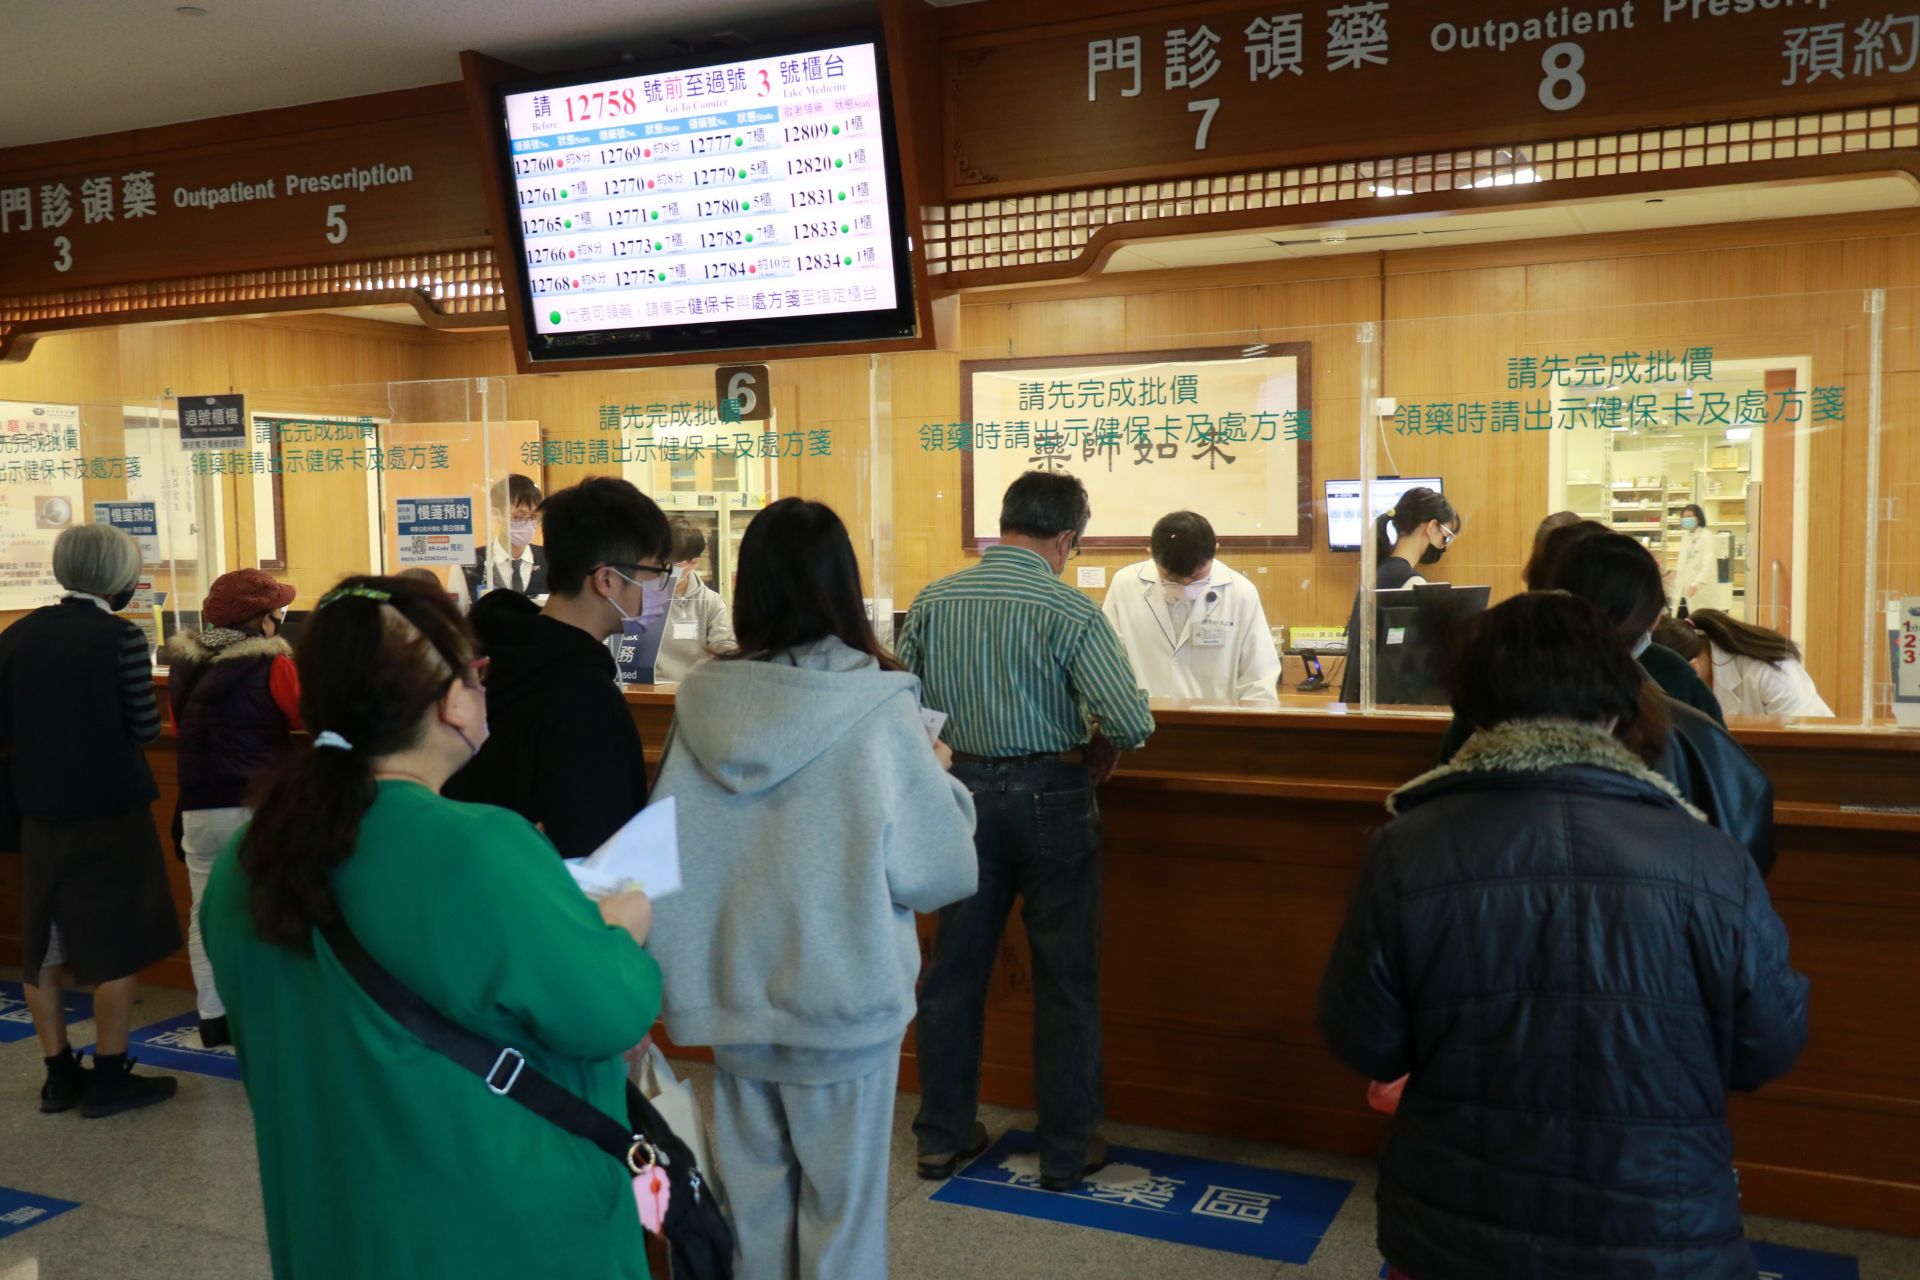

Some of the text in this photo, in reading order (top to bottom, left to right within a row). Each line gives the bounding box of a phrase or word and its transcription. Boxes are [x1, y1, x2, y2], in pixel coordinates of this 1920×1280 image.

[1431, 1, 1635, 52] Outpatient
[1088, 1, 1390, 102] 門診領藥
[1781, 14, 1920, 86] 預約
[533, 54, 845, 123] 請 12758 號前至過號 3 號櫃台
[1538, 42, 1586, 111] 8
[532, 83, 848, 132] Before Go To Counter Take Medicine
[1187, 98, 1221, 150] 7
[515, 156, 554, 175] 12760
[600, 145, 641, 165] 12769
[690, 134, 731, 154] 12777
[784, 123, 828, 143] 12809
[0, 171, 157, 233] 門診領藥
[173, 163, 414, 210] Outpatient Prescription
[519, 187, 557, 205] 12761
[604, 177, 645, 196] 12770
[693, 166, 736, 186] 12779
[787, 156, 832, 176] 12820
[326, 204, 348, 244] 5
[523, 217, 562, 235] 12765
[608, 208, 647, 226] 12771
[697, 198, 739, 217] 12780
[790, 189, 833, 208] 12831
[54, 236, 73, 273] 3
[527, 248, 566, 264] 12766
[612, 238, 651, 256] 12773
[700, 230, 742, 248] 12782
[794, 221, 837, 239] 12833
[531, 277, 570, 293] 12768
[615, 269, 655, 287] 12775
[704, 261, 746, 279] 12784
[797, 253, 840, 271] 12834
[1507, 346, 1714, 390] 請先完成批價
[600, 398, 742, 431] 請先完成批價
[727, 371, 757, 417] 6
[1018, 374, 1198, 411] 請先完成批價
[1394, 386, 1846, 436] 領藥時請出示健保卡及處方箋
[255, 415, 374, 444] 請先完成批價
[520, 429, 832, 466] 領藥時請出示健保卡及處方箋
[919, 409, 1312, 452] 領藥時請出示健保卡及處方箋
[191, 445, 449, 476] 領藥時請出示健保卡及處方箋
[417, 503, 469, 520] 慢箋預約
[1902, 620, 1911, 632] 1
[1904, 634, 1917, 648] 2
[1904, 649, 1917, 664] 3
